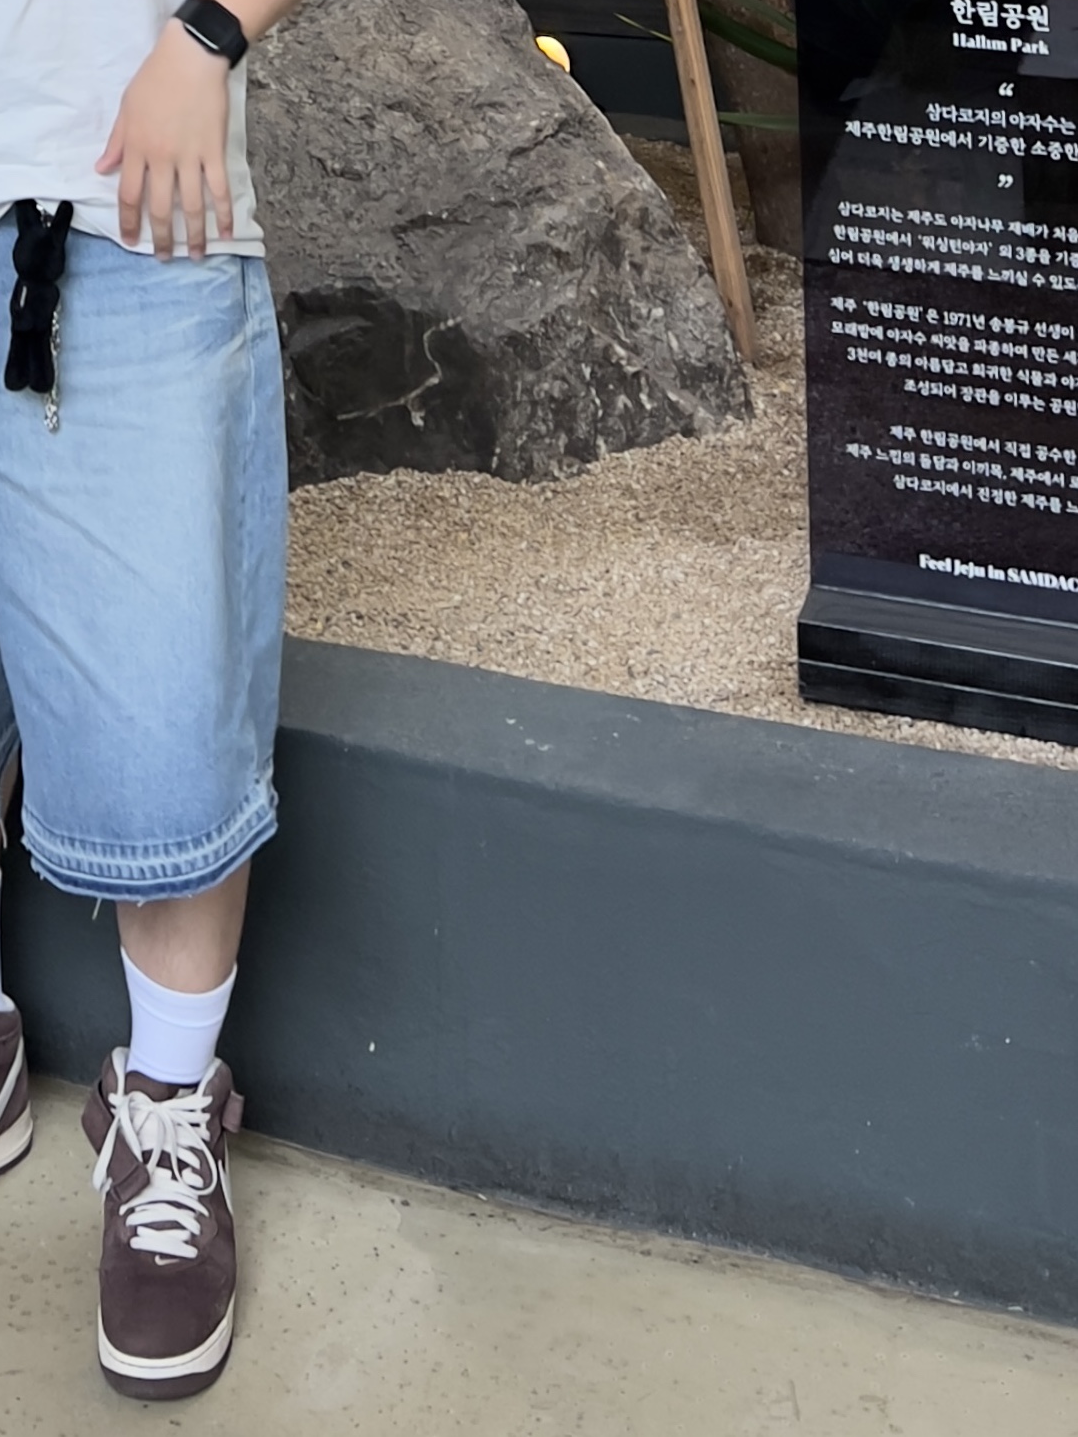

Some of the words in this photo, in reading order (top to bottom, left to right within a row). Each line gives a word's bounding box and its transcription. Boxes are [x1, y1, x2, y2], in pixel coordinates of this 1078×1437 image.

[953, 33, 1007, 51] Hallim
[1011, 38, 1049, 55] Park
[1009, 112, 1075, 135] 야자수는
[846, 121, 972, 149] 제주한림공원에서
[979, 134, 1026, 155] 기증한
[1031, 141, 1078, 161] 소중한
[834, 225, 911, 246] 한림공원에서
[907, 210, 947, 226] 제주도
[951, 215, 1004, 233] 야자나무
[829, 248, 853, 264] 심어
[858, 252, 883, 268] 더욱
[888, 256, 940, 274] 생생하게
[944, 262, 984, 281] 제주를
[987, 268, 1027, 286] 느끼실
[1032, 273, 1045, 287] 수
[1049, 275, 1078, 290] 있도
[831, 297, 856, 312] 제주
[926, 309, 939, 324] 은
[944, 311, 985, 330] 1971년
[1035, 322, 1074, 339] 선생이
[832, 321, 883, 340] 모래밭에
[887, 328, 926, 345] 야자수
[931, 334, 970, 352] 씨앗을
[974, 339, 1027, 358] 파종하여
[1032, 347, 1059, 363] 만든
[915, 356, 968, 374] 아름답고
[973, 364, 1012, 382] 희귀한
[1017, 369, 1057, 386] 식물과
[904, 379, 956, 398] 조성되어
[961, 386, 1000, 405] 장관을
[1005, 393, 1045, 411] 이루는
[890, 426, 916, 441] 제주
[921, 429, 999, 453] 한림공원에서
[1005, 442, 1030, 458] 직접
[1036, 446, 1076, 465] 공수한
[846, 443, 872, 459] 제주
[876, 448, 915, 465] 느낌의
[920, 454, 959, 472] 돌담과
[1011, 467, 1064, 487] 제주에서
[978, 487, 1017, 506] 진정한
[1022, 494, 1061, 513] 제주를
[920, 554, 952, 572] Feel
[954, 560, 985, 578] Jeju
[988, 565, 1005, 580] in
